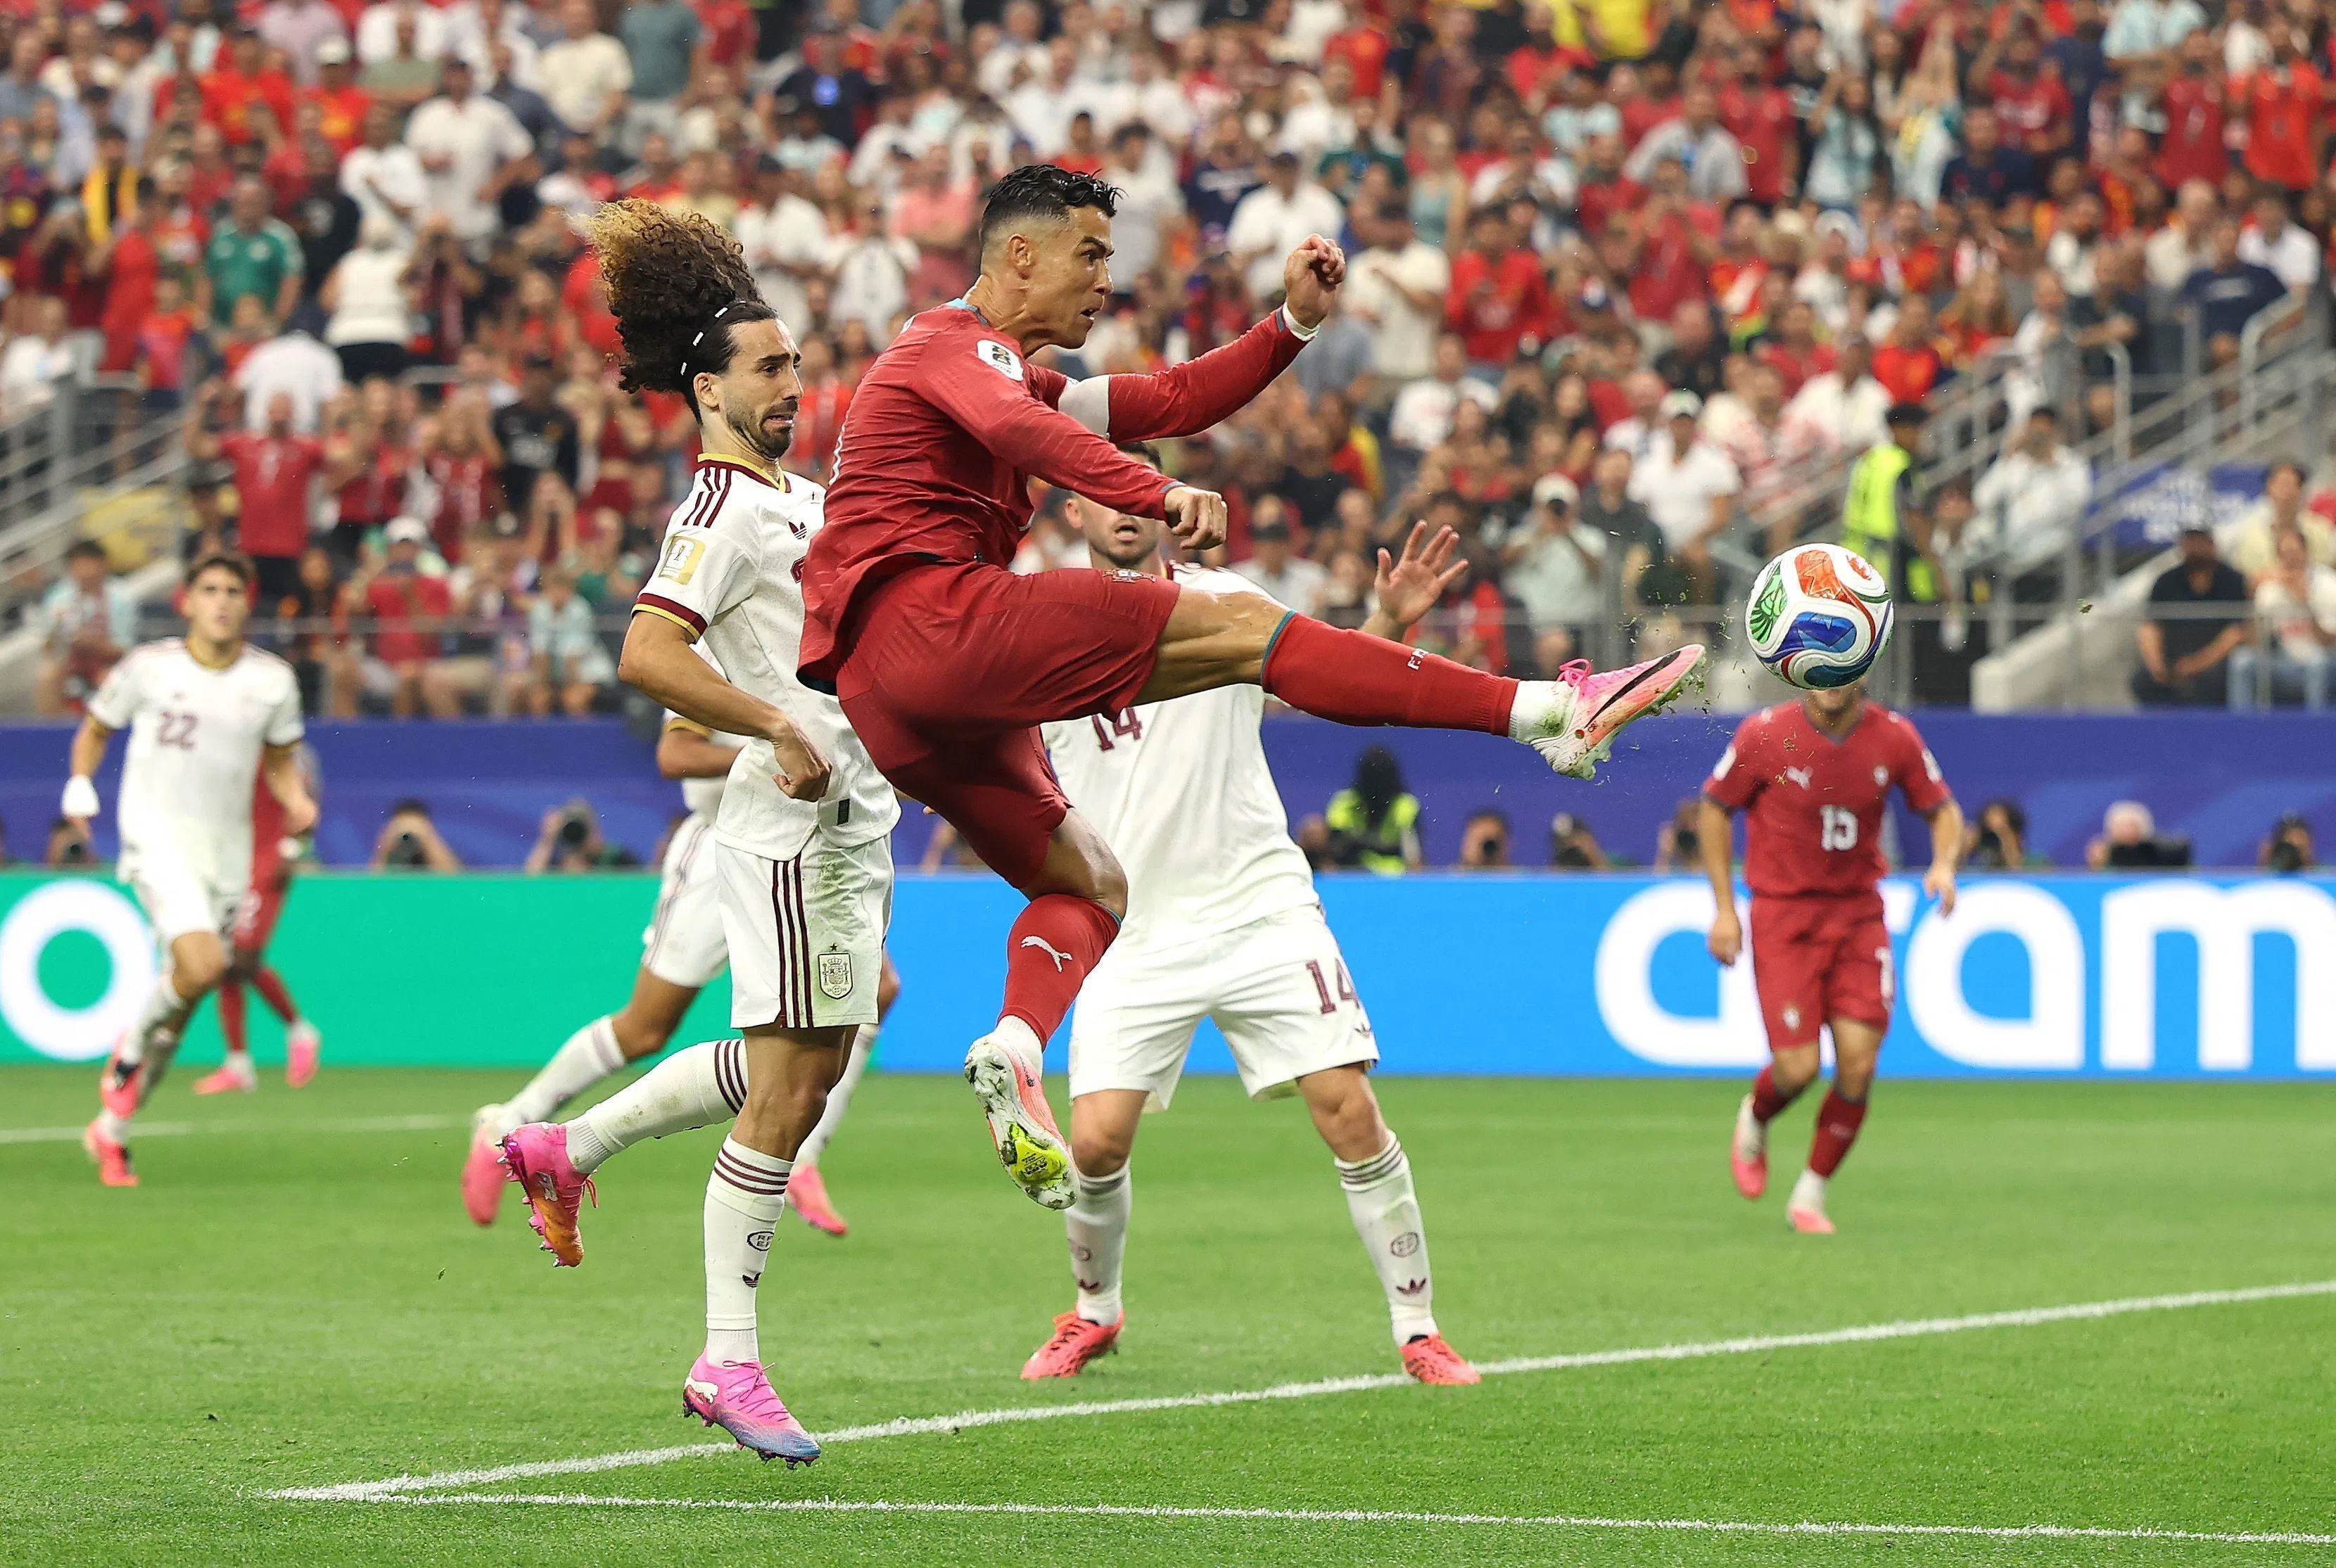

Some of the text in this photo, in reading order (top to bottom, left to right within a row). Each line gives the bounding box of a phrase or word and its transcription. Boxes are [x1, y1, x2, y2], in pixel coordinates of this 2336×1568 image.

[158, 710, 198, 750] 22
[1092, 708, 1142, 752] 14
[1820, 805, 1859, 852] 15
[1306, 958, 1359, 1014] 14
